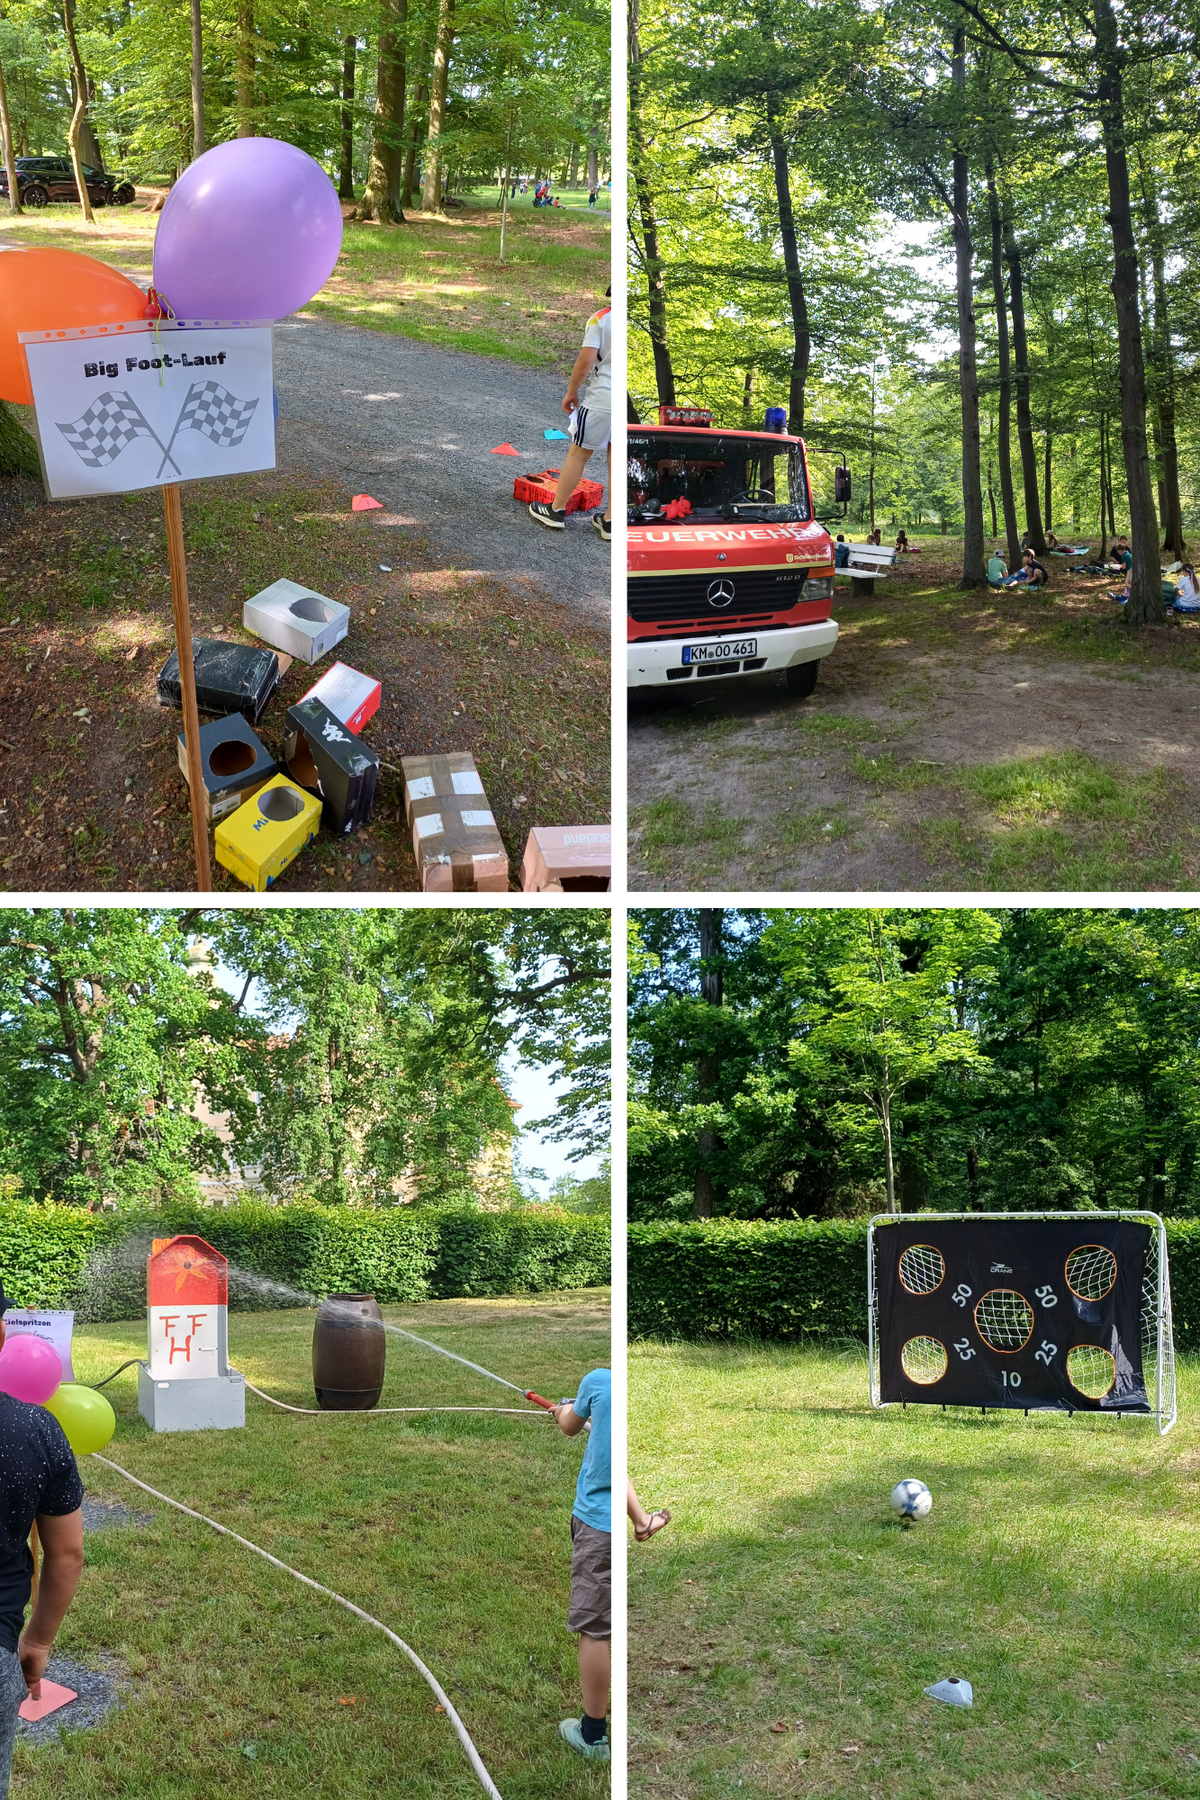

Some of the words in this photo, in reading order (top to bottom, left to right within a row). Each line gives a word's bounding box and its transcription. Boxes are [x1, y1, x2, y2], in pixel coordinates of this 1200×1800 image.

[84, 361, 119, 378] Big
[125, 351, 227, 372] Foot-Lauf
[691, 646, 708, 660] KM
[733, 642, 754, 655] 461
[951, 1283, 973, 1307] 50
[1034, 1284, 1058, 1308] 50
[169, 1334, 192, 1365] H
[953, 1337, 976, 1361] 25
[1034, 1340, 1058, 1366] 25
[1001, 1370, 1022, 1387] 10
